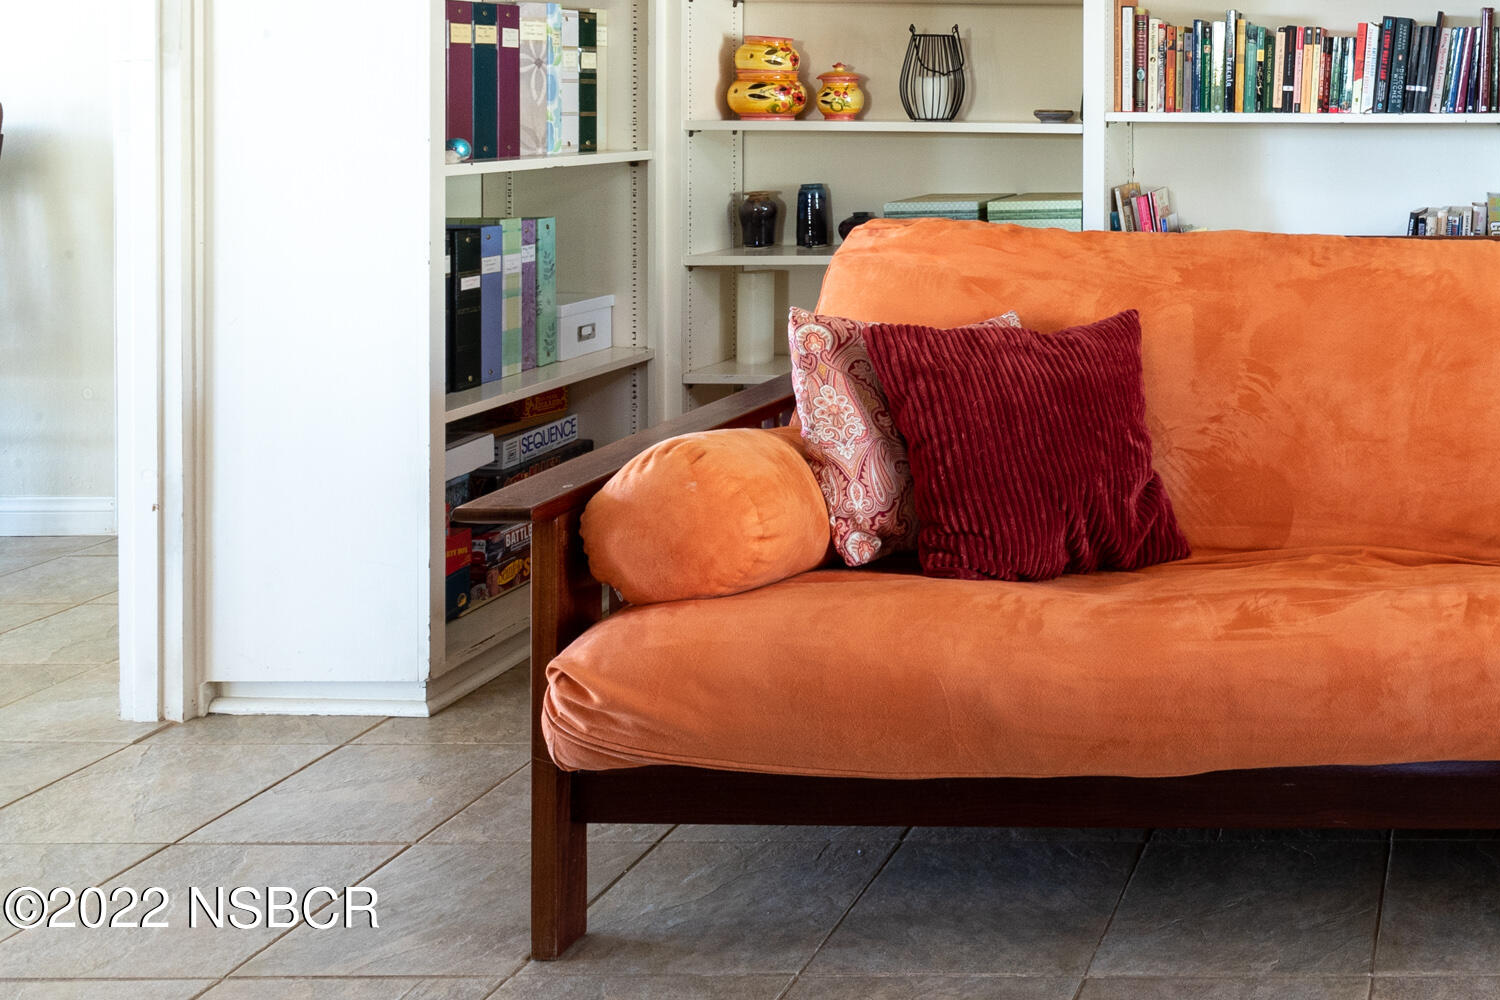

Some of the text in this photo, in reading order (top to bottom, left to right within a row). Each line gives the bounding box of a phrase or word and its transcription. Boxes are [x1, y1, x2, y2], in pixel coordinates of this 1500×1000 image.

[1391, 73, 1399, 104] WITCHES
[1396, 68, 1405, 108] DISCOVERY
[521, 417, 577, 455] SEQUENCE
